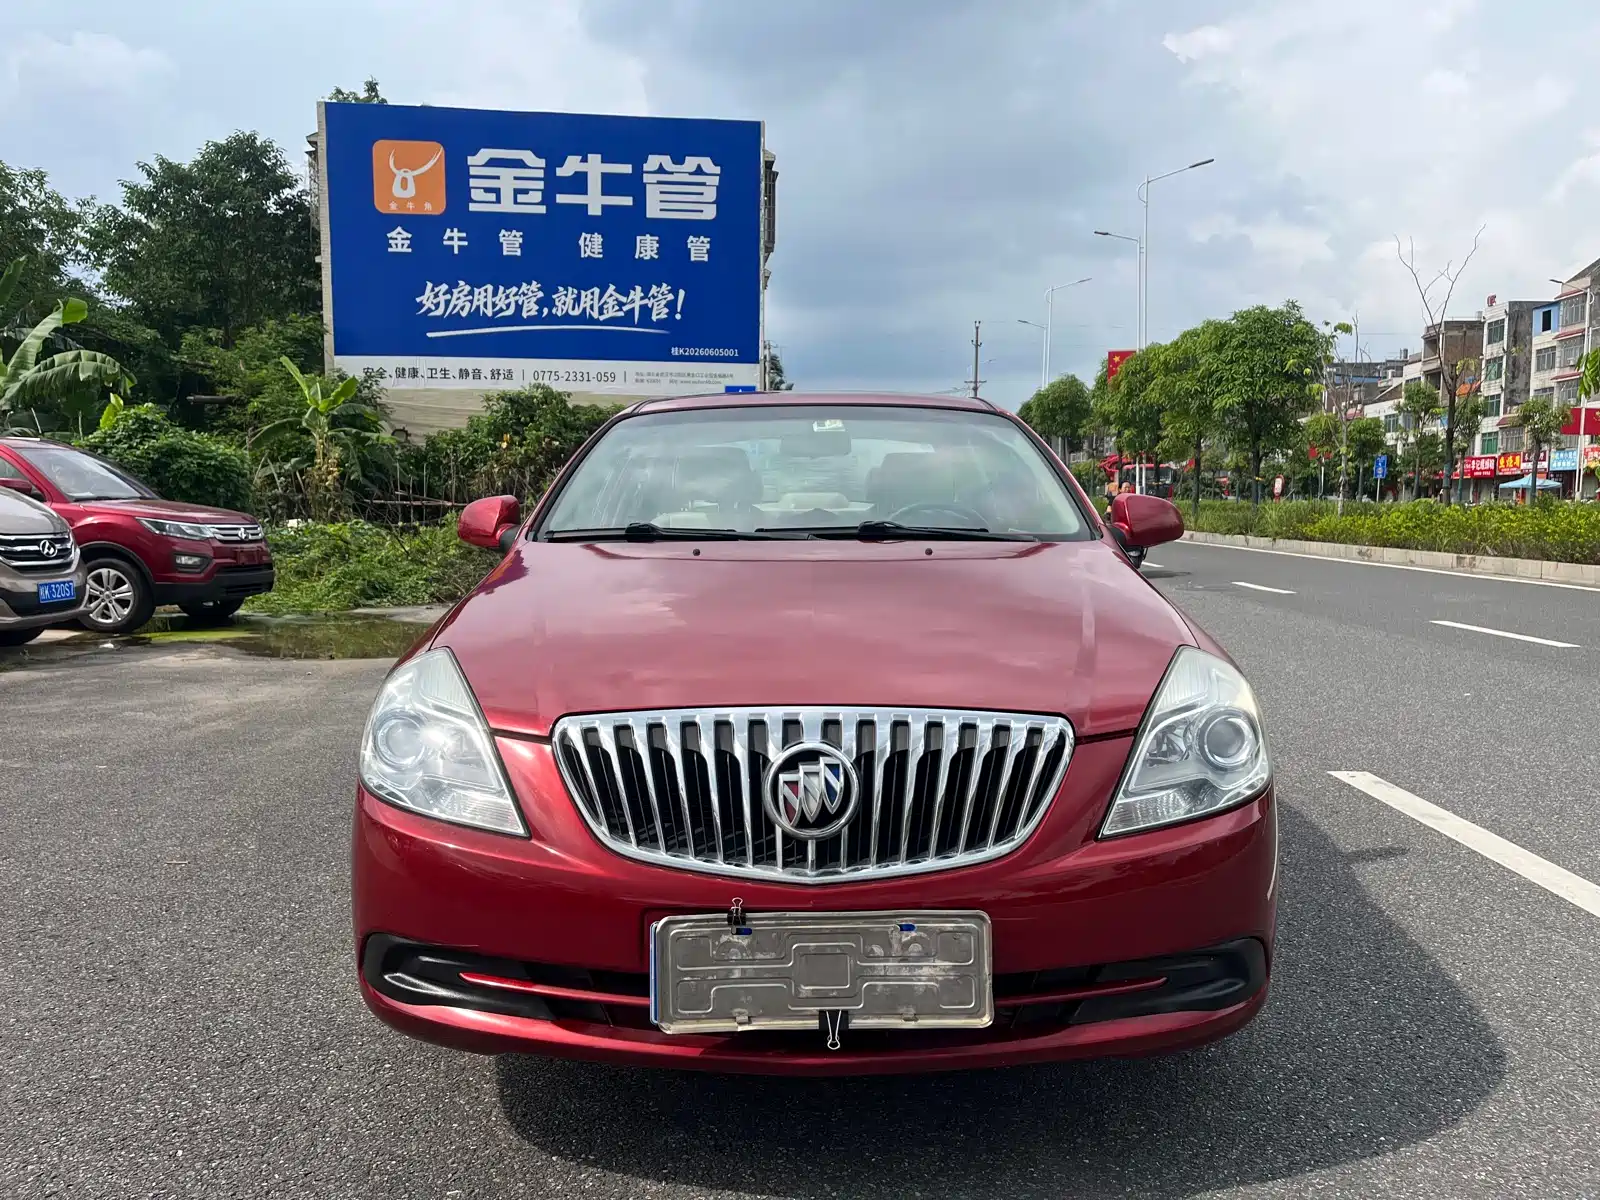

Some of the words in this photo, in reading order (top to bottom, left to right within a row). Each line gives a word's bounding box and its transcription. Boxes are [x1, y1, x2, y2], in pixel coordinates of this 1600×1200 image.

[466, 147, 722, 221] 金牛管
[388, 200, 433, 211] 金牛角
[386, 226, 524, 257] 金牛管
[578, 231, 711, 262] 健康管
[670, 346, 739, 358] 桂K20260605001
[533, 369, 616, 383] 0775-2331-059
